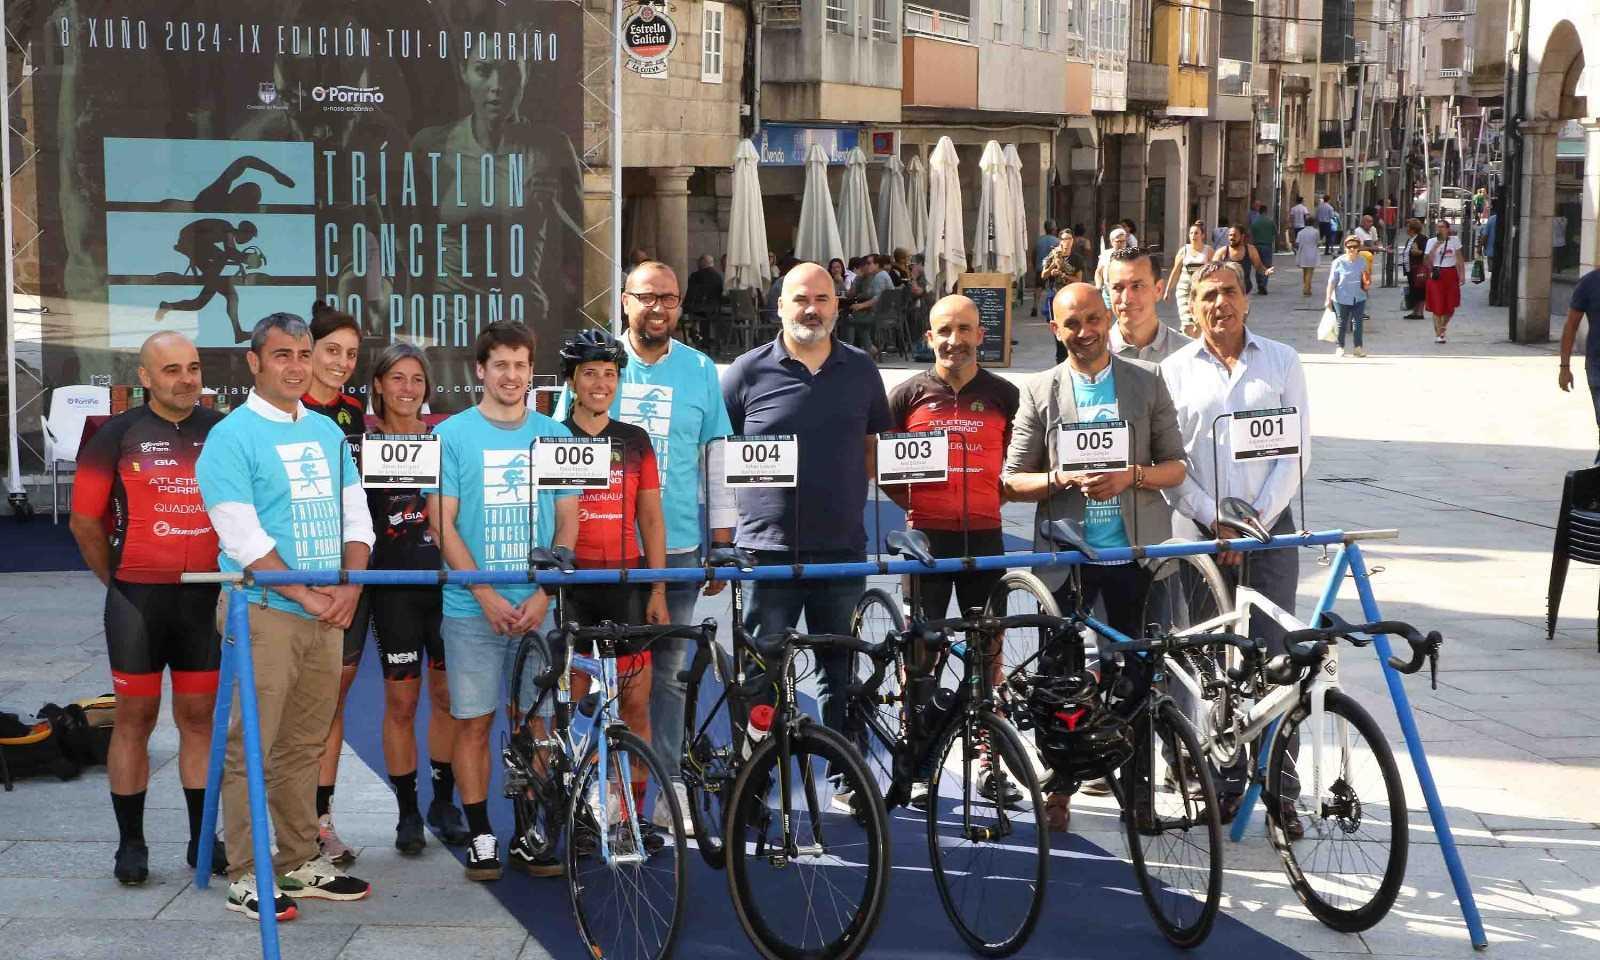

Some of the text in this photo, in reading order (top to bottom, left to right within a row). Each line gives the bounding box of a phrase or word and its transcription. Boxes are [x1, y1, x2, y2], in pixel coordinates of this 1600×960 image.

[61, 17, 70, 47] 8
[89, 16, 147, 49] XUÑO
[464, 29, 557, 61] PORRIÑO
[630, 24, 666, 34] Estrella
[632, 34, 665, 44] Galicia
[323, 141, 523, 207] TRÍATLON
[324, 222, 524, 277] CONCELLO
[389, 287, 524, 347] PORRIÑO
[1250, 417, 1284, 438] 001
[1076, 431, 1113, 450] 005
[381, 443, 422, 462] 007
[555, 446, 594, 465] 006
[742, 444, 780, 462] 004
[895, 441, 932, 460] 003
[404, 512, 424, 520] GIA
[387, 651, 418, 664] NSN
